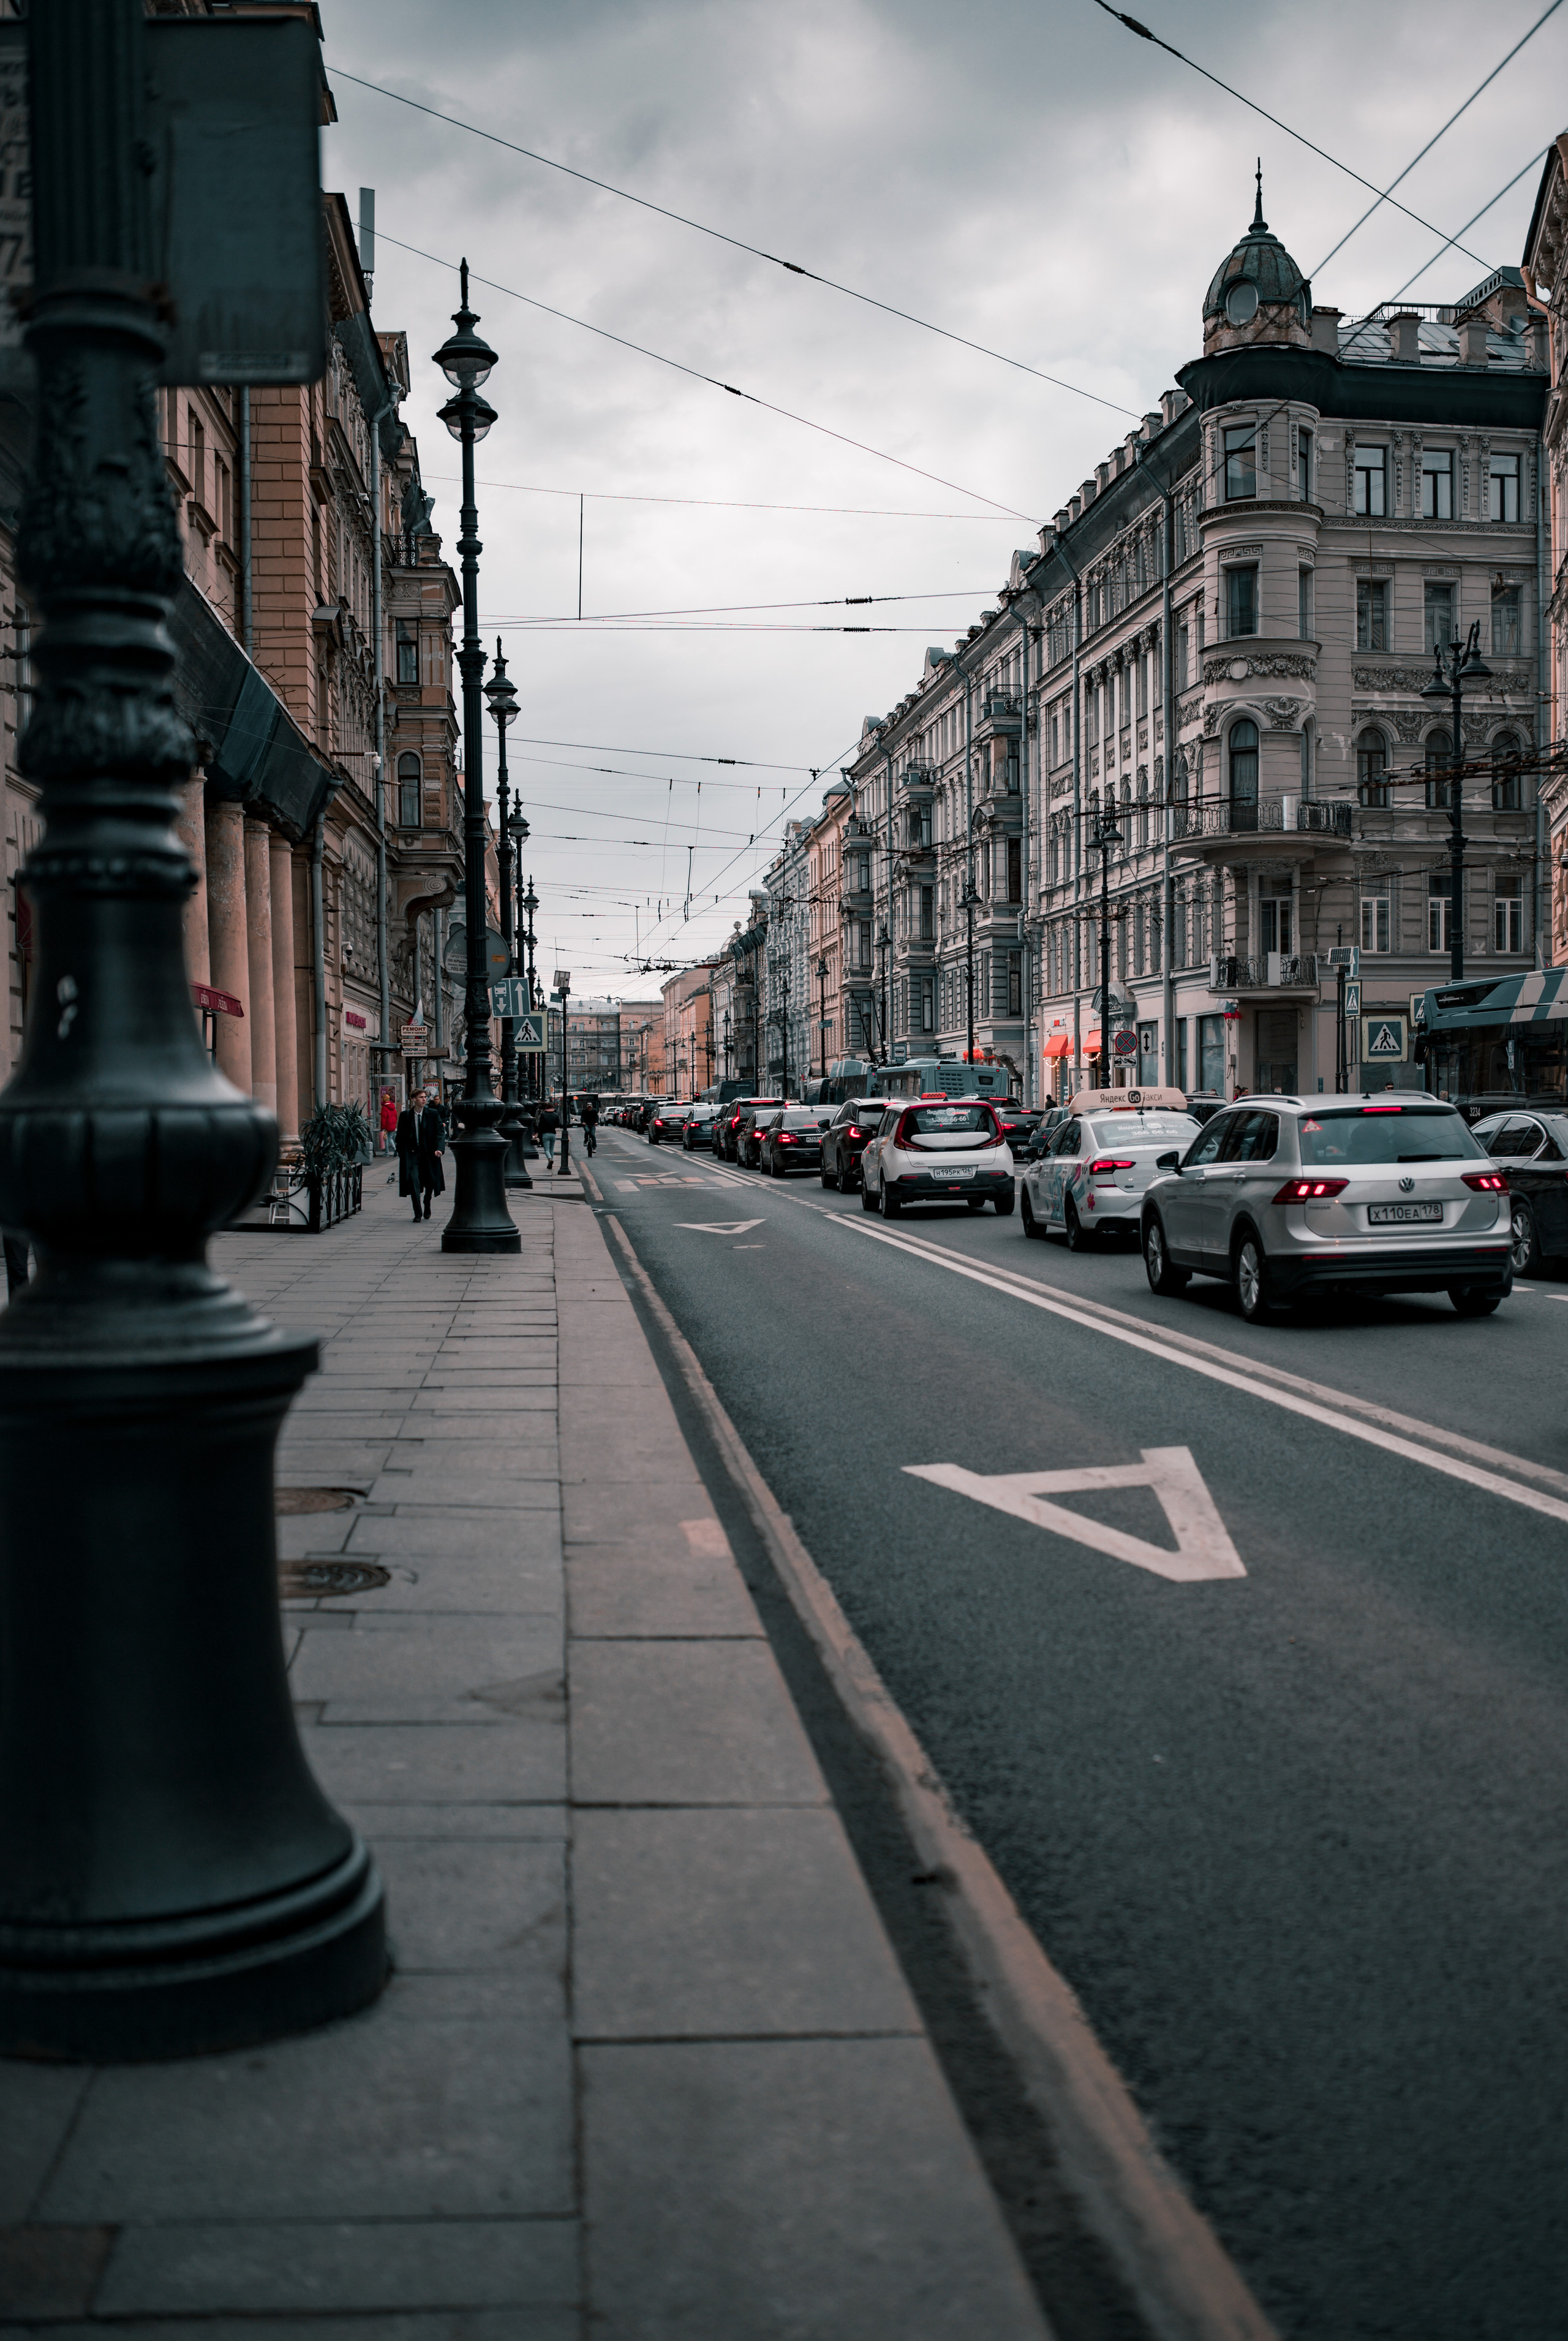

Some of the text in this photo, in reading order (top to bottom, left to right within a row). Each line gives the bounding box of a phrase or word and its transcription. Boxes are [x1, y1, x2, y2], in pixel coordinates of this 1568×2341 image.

[1100, 1092, 1163, 1103] Яндекс Go Такси
[1469, 1106, 1480, 1117] 3234
[1373, 1205, 1439, 1220] Х110ЕА 178
